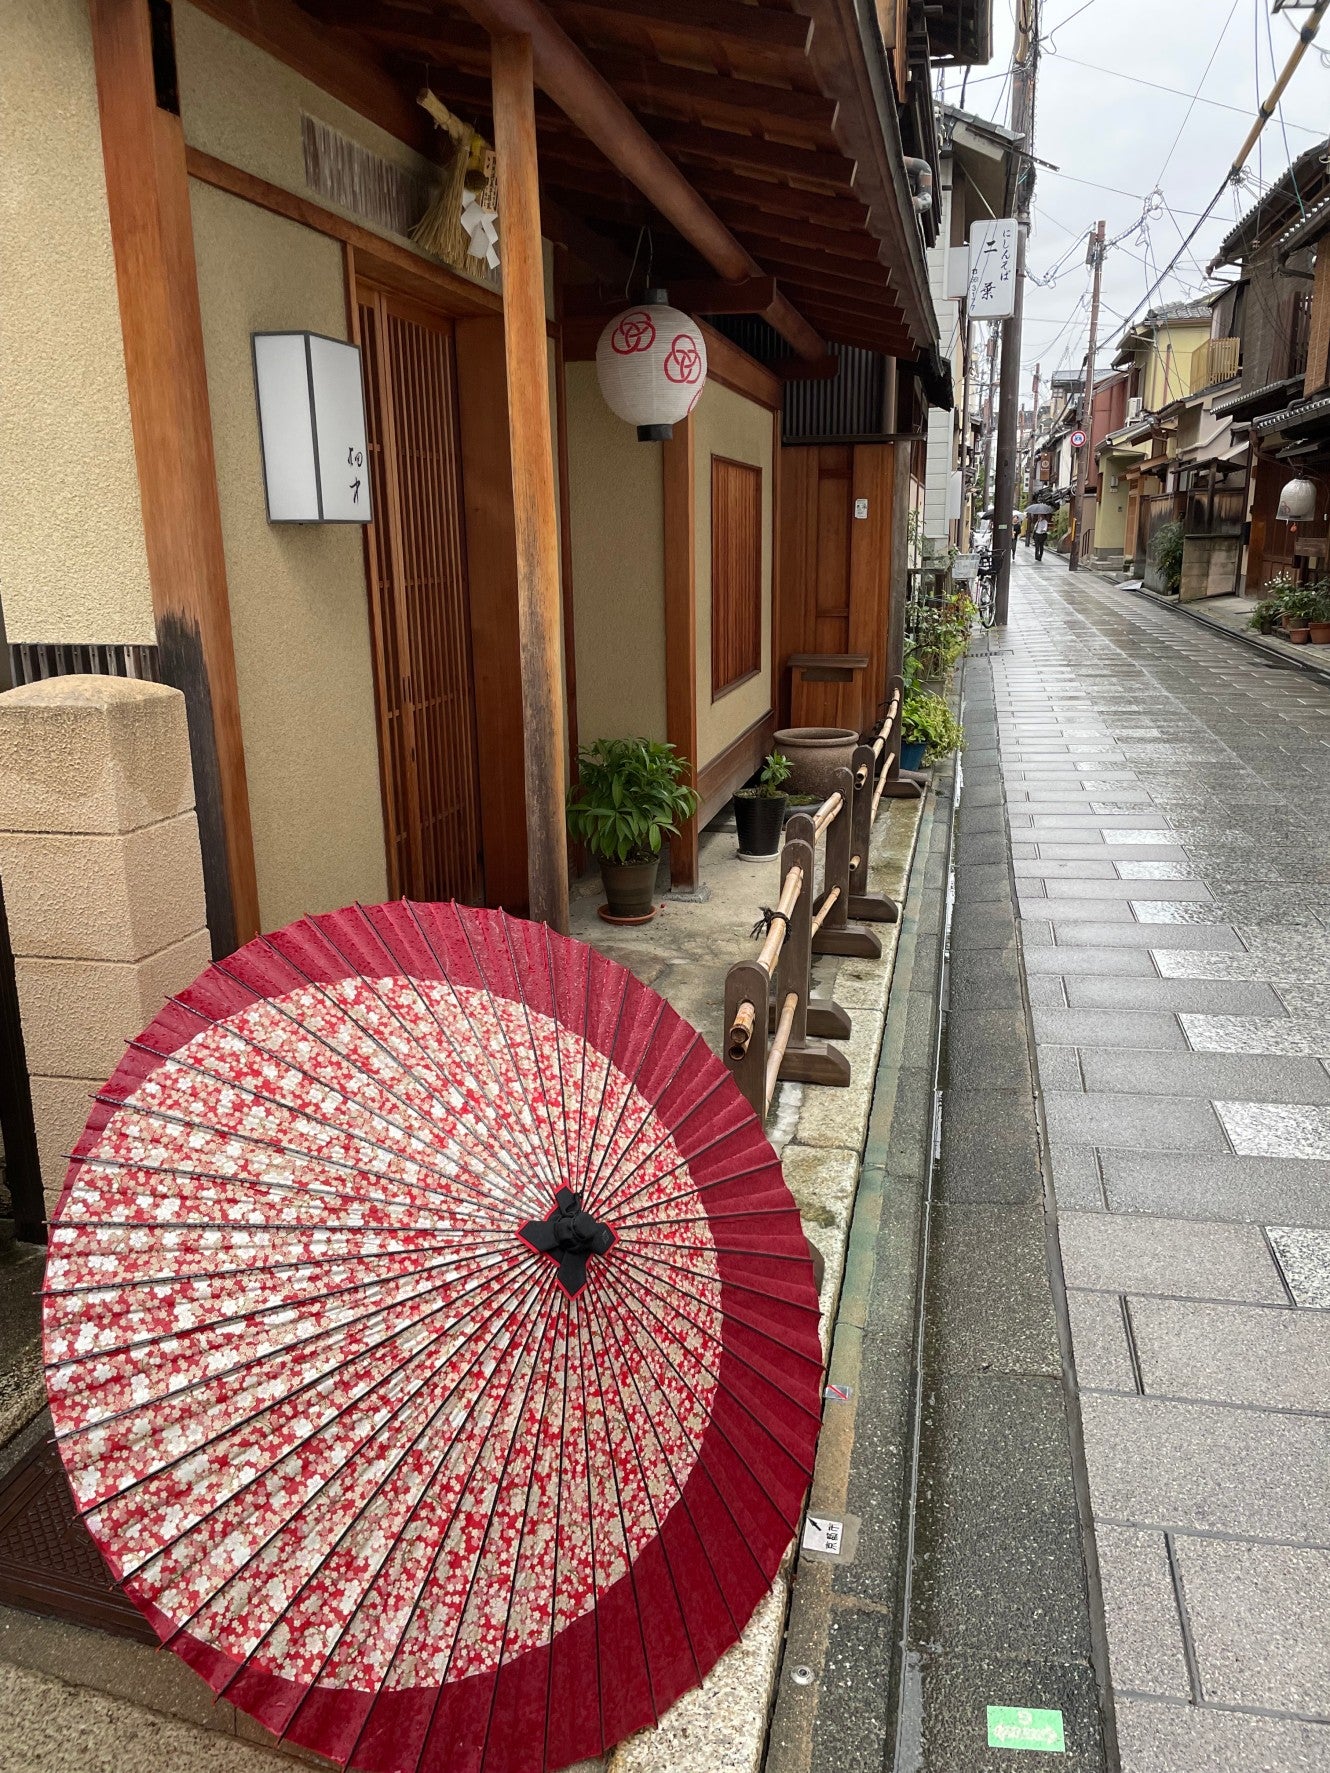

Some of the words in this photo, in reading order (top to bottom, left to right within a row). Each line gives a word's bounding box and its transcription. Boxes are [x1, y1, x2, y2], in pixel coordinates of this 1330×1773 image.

[1000, 229, 1010, 281] にしんそば
